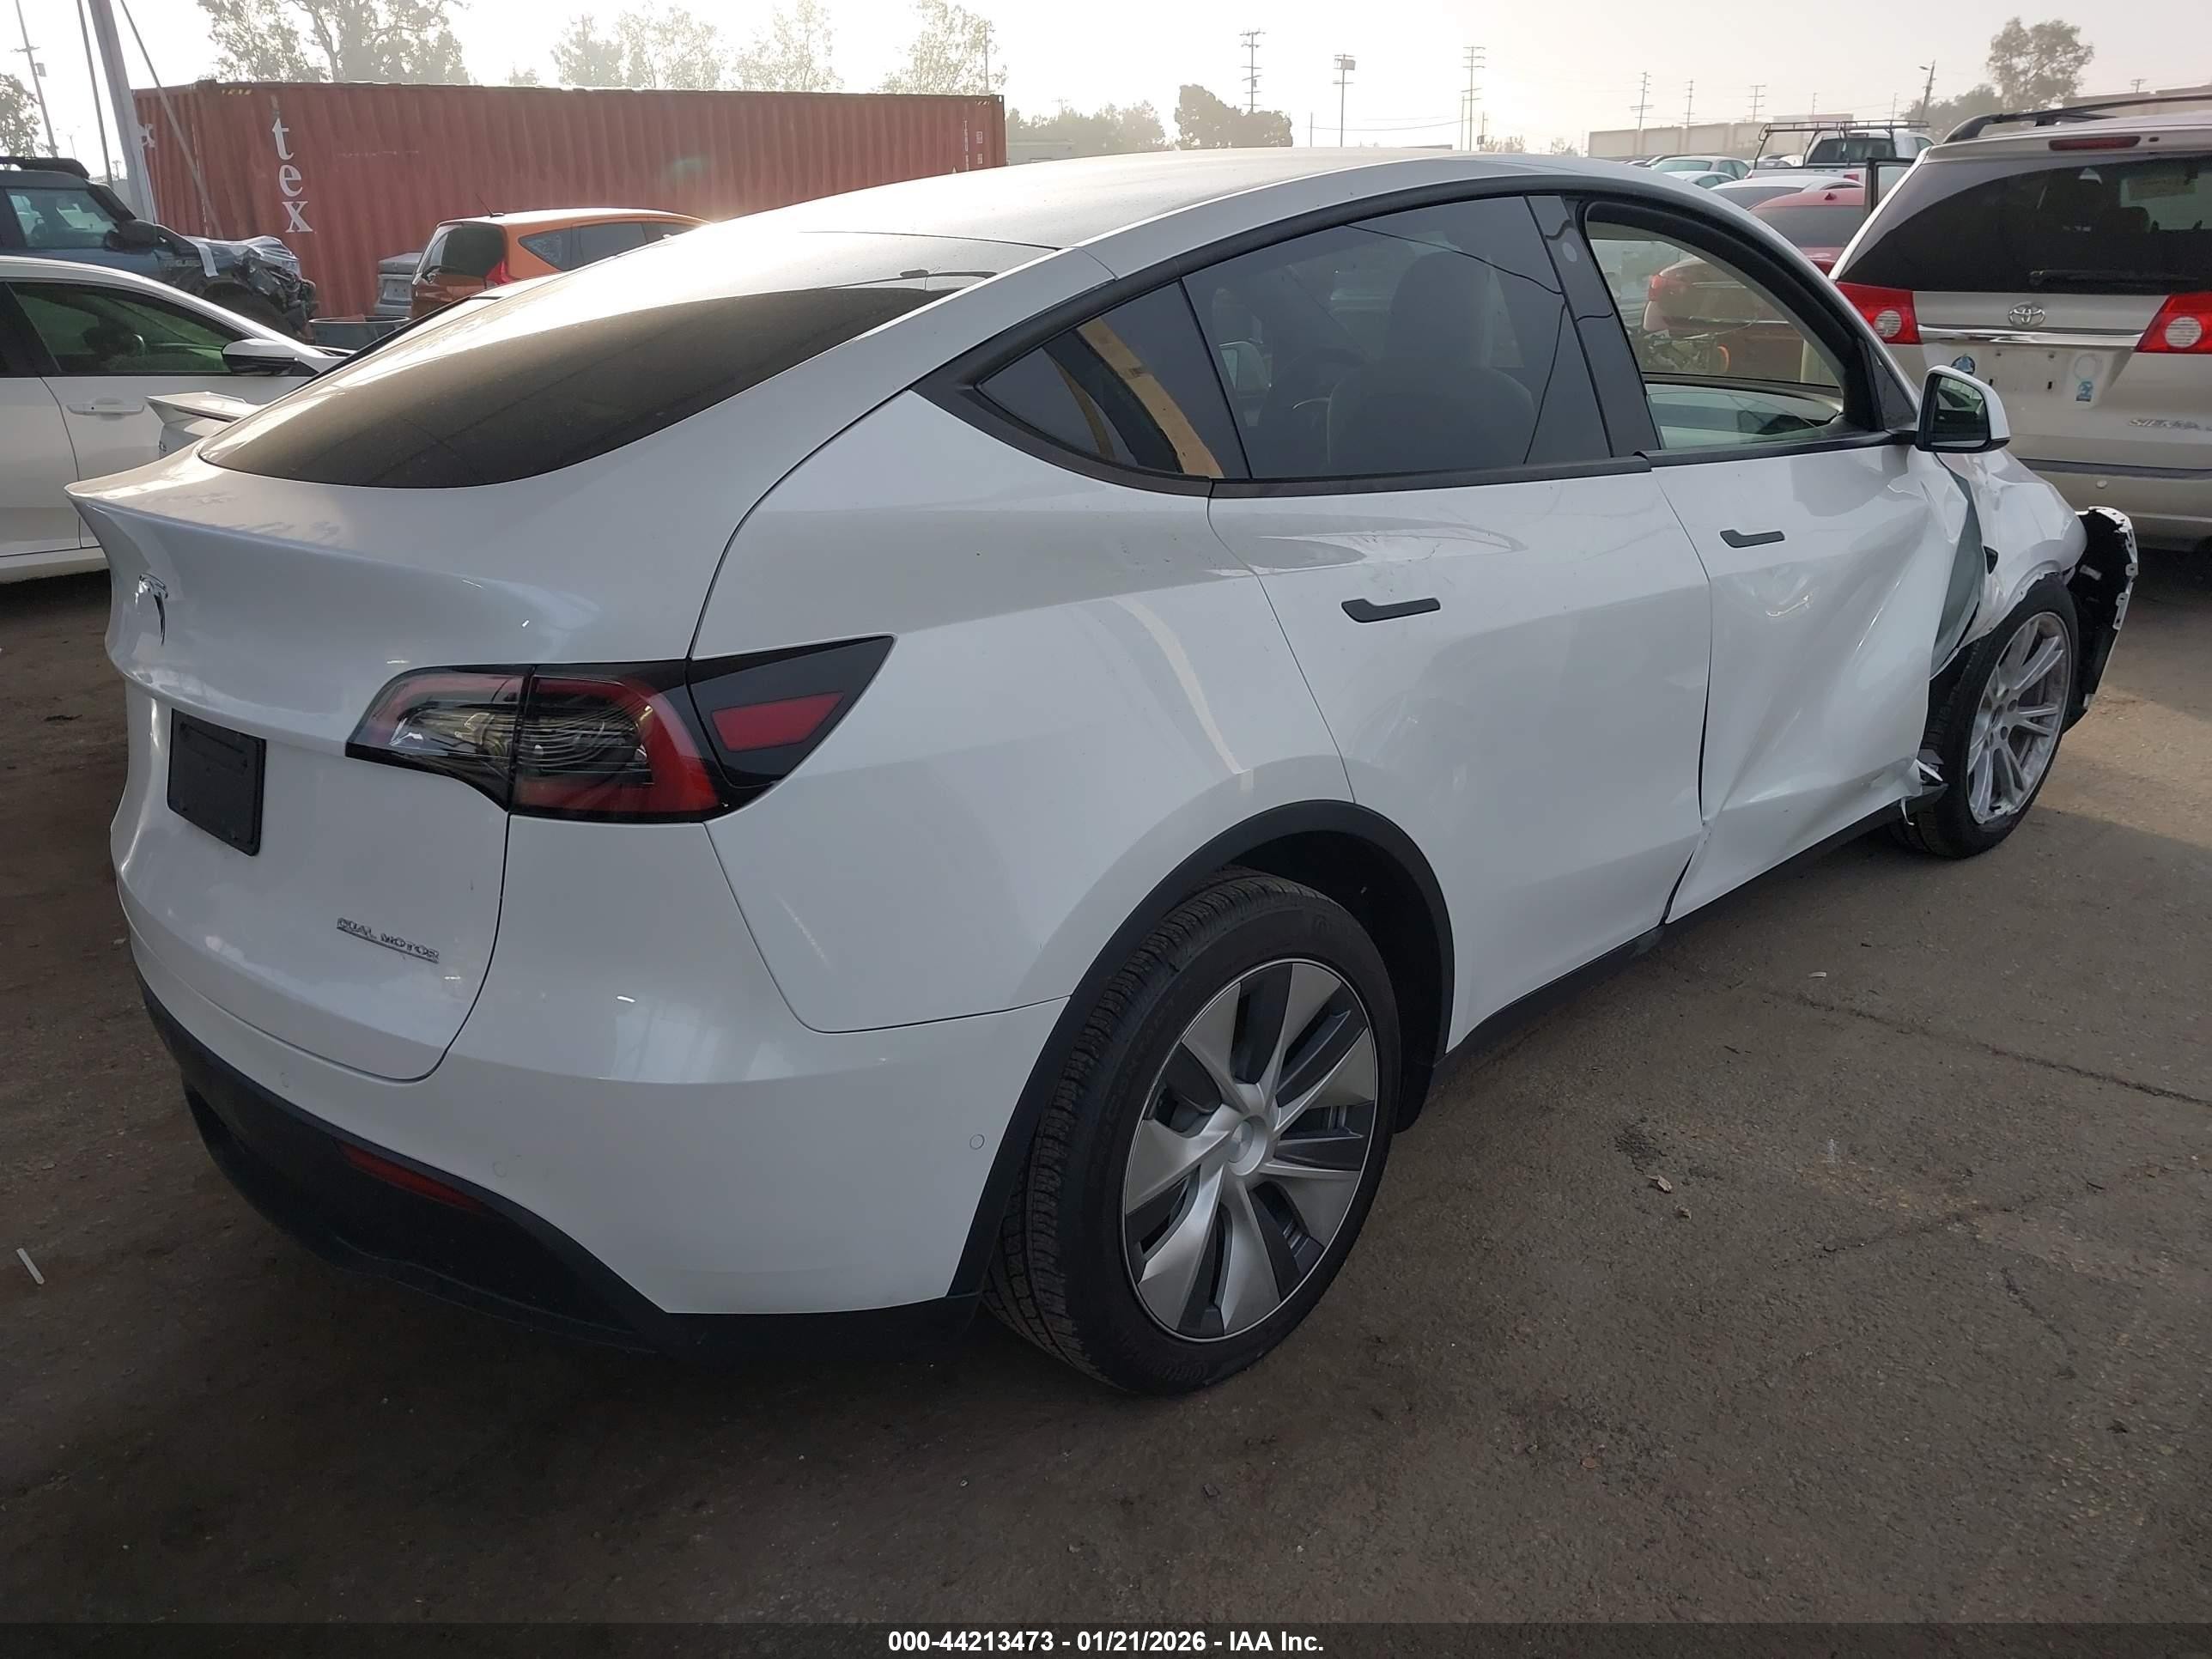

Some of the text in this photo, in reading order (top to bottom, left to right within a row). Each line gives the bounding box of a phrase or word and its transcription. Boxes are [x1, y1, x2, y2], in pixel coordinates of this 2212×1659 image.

[271, 118, 313, 233] tex
[337, 917, 440, 960] DUAL MOTOR
